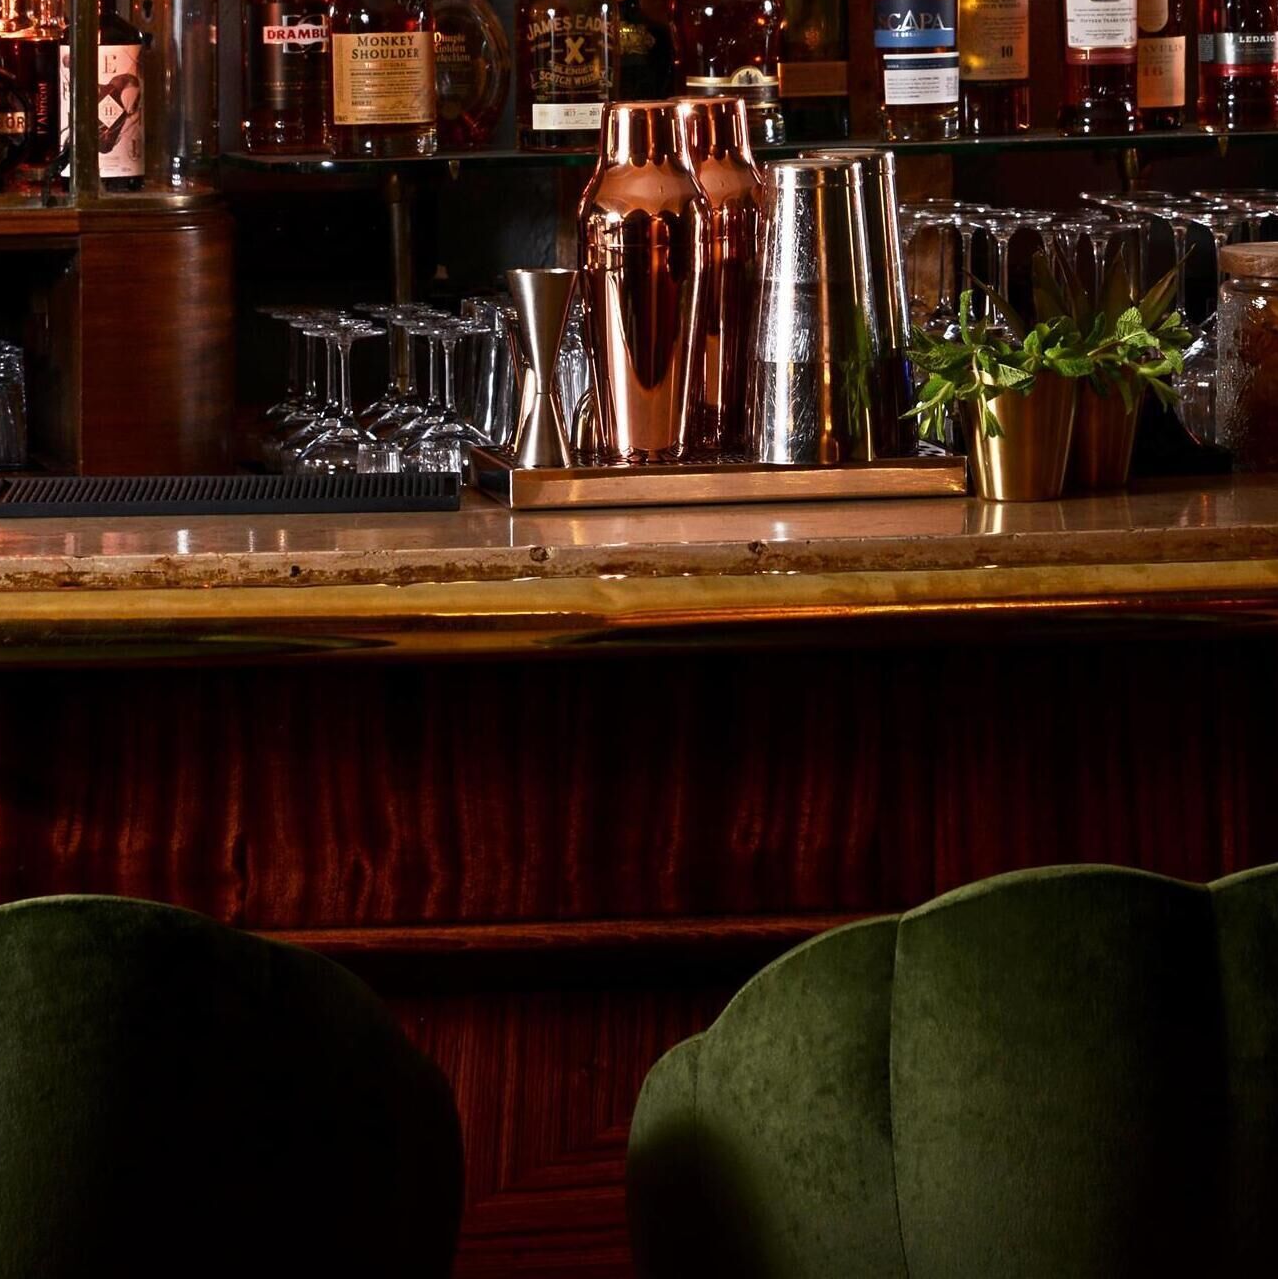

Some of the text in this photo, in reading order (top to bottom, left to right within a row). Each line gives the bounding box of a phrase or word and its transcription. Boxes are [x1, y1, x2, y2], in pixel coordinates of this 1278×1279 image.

[886, 9, 954, 32] CAPA
[266, 27, 328, 40] DRAMBU
[526, 15, 573, 41] JAMES
[357, 35, 415, 48] MONKEY
[1141, 43, 1184, 52] AVULIN
[351, 47, 420, 60] SHOULDER
[564, 36, 585, 65] X
[1000, 45, 1014, 58] 10
[435, 53, 471, 62] election
[538, 70, 572, 86] SCOTCH
